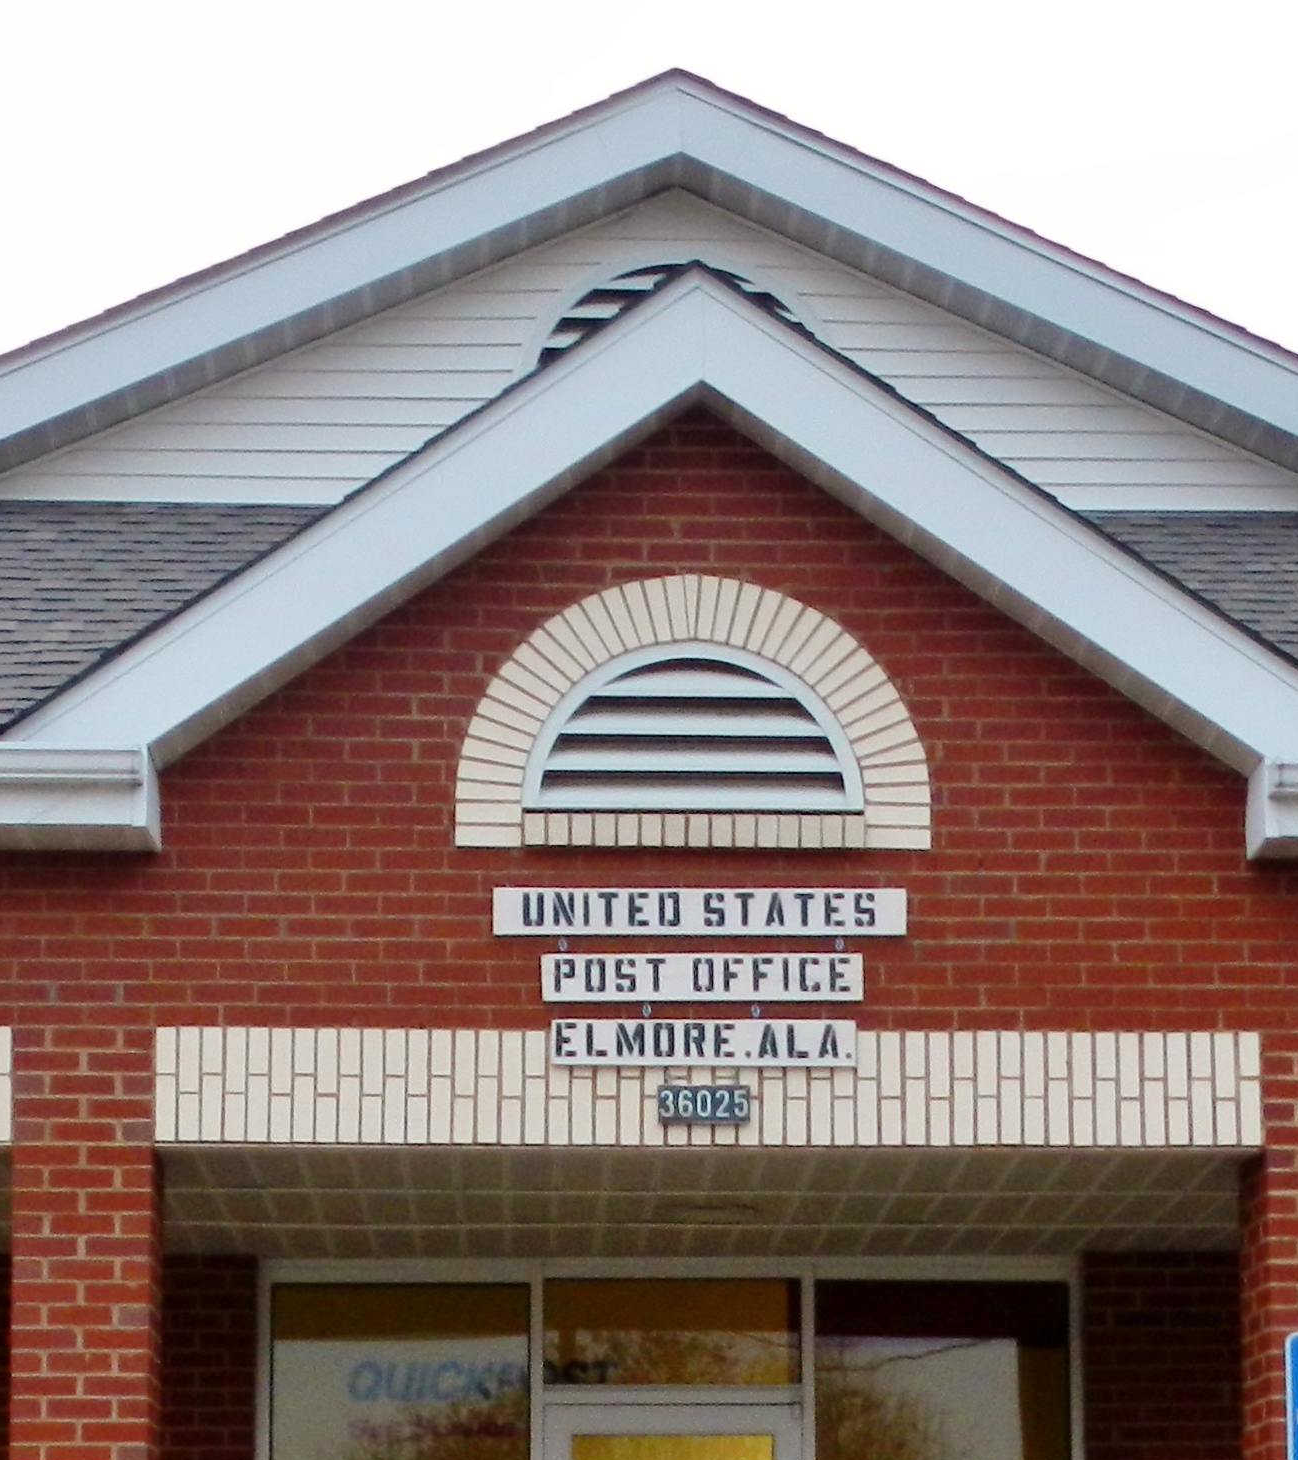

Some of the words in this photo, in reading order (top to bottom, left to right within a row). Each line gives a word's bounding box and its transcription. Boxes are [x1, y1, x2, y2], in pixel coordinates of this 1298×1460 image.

[522, 891, 681, 927] UNITED
[703, 892, 877, 927] STATES
[553, 958, 667, 993] POST
[692, 957, 851, 993] OFFICE
[659, 1089, 750, 1119] 36025
